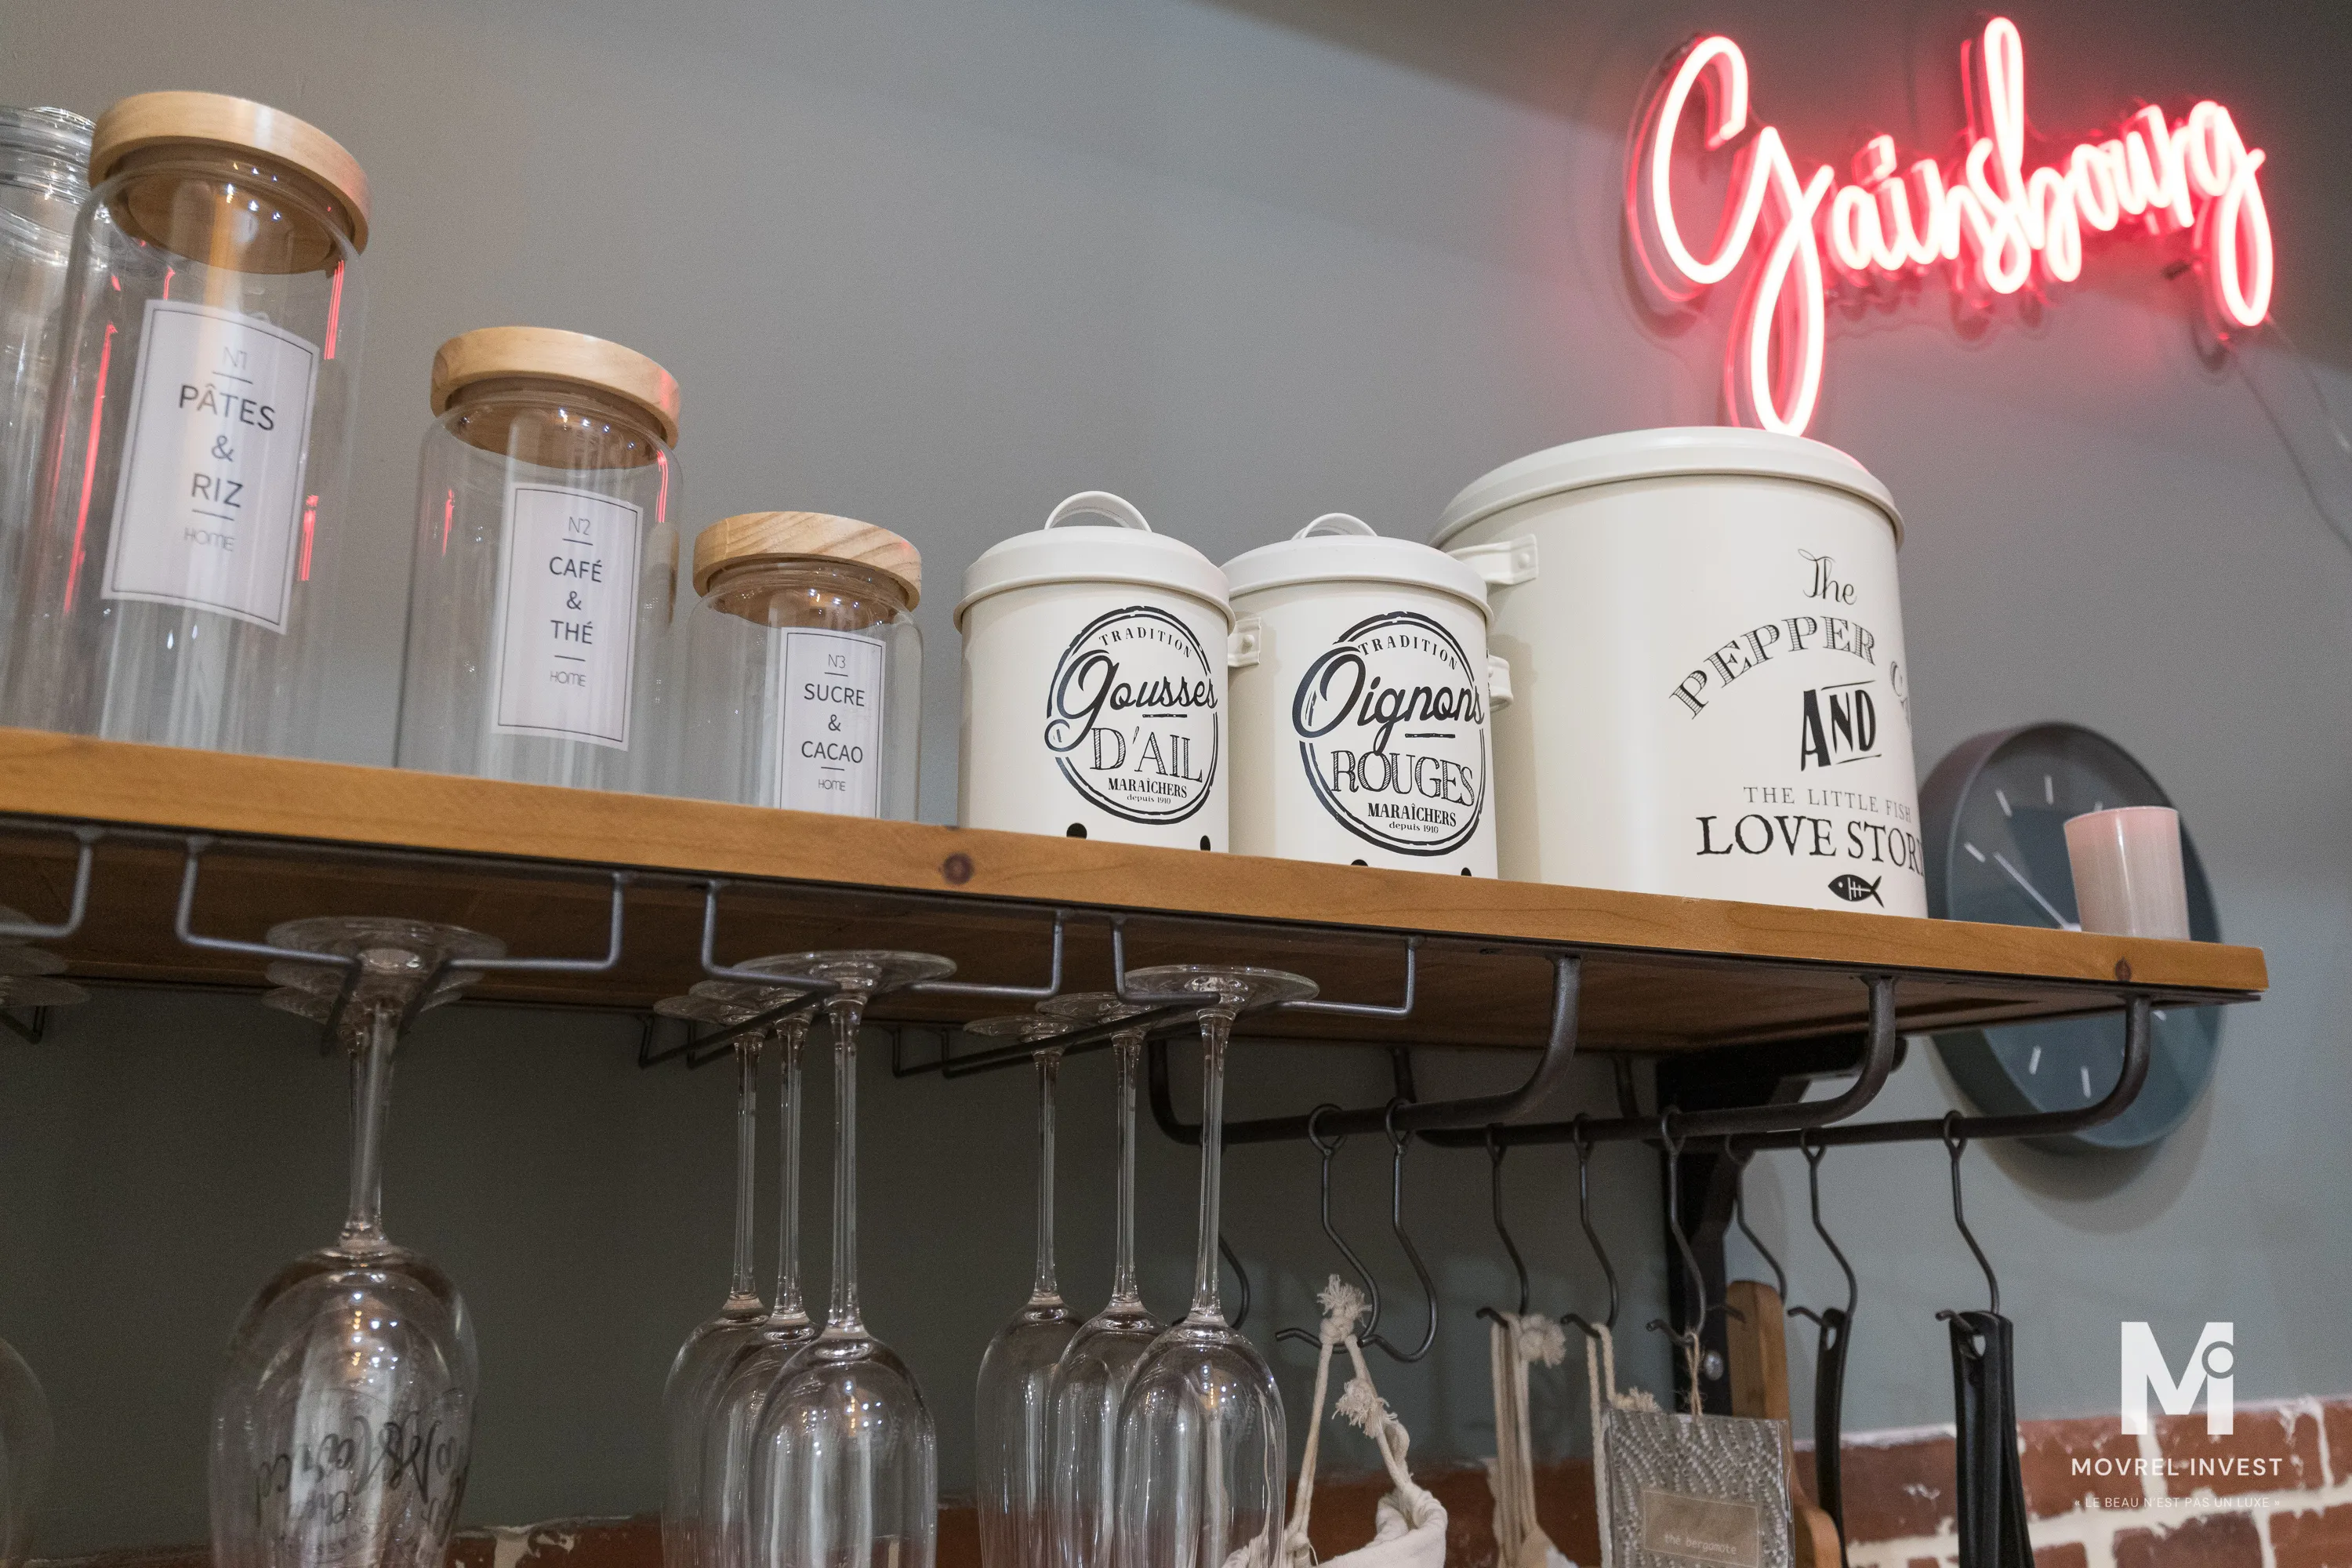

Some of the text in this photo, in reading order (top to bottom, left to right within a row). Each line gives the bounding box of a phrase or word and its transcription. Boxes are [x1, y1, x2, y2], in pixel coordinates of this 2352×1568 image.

[1651, 16, 2275, 437] Gainsbourg
[178, 383, 276, 431] PÂTES
[210, 434, 234, 463] &
[191, 472, 244, 508] RIZ
[549, 555, 603, 583] CAFÉ
[1797, 547, 1858, 606] The
[566, 590, 582, 611] &
[550, 620, 593, 644] THÉ
[1098, 626, 1192, 659] TRADITION
[1357, 634, 1458, 670] TRADITION
[550, 671, 586, 688] HOME
[1668, 615, 1876, 720] PEPPER
[803, 683, 866, 707] SUCRE
[1291, 645, 1486, 757] Oignons
[828, 713, 841, 732] &
[1800, 688, 1877, 772] AND
[801, 740, 863, 764] CACAO
[1089, 725, 1203, 783] D'AIL
[818, 779, 847, 792] HOME
[1107, 777, 1188, 799] MARAÎCHERS
[1330, 750, 1475, 807] ROUGES
[1127, 793, 1172, 805] depuis 1910
[1742, 785, 1912, 823] THE LITTLE FISH
[1367, 802, 1457, 827] MARAÎCHERS
[1388, 821, 1439, 834] depuis 1910
[1695, 813, 1838, 856] LOVE
[1686, 1537, 1737, 1555] bergamote
